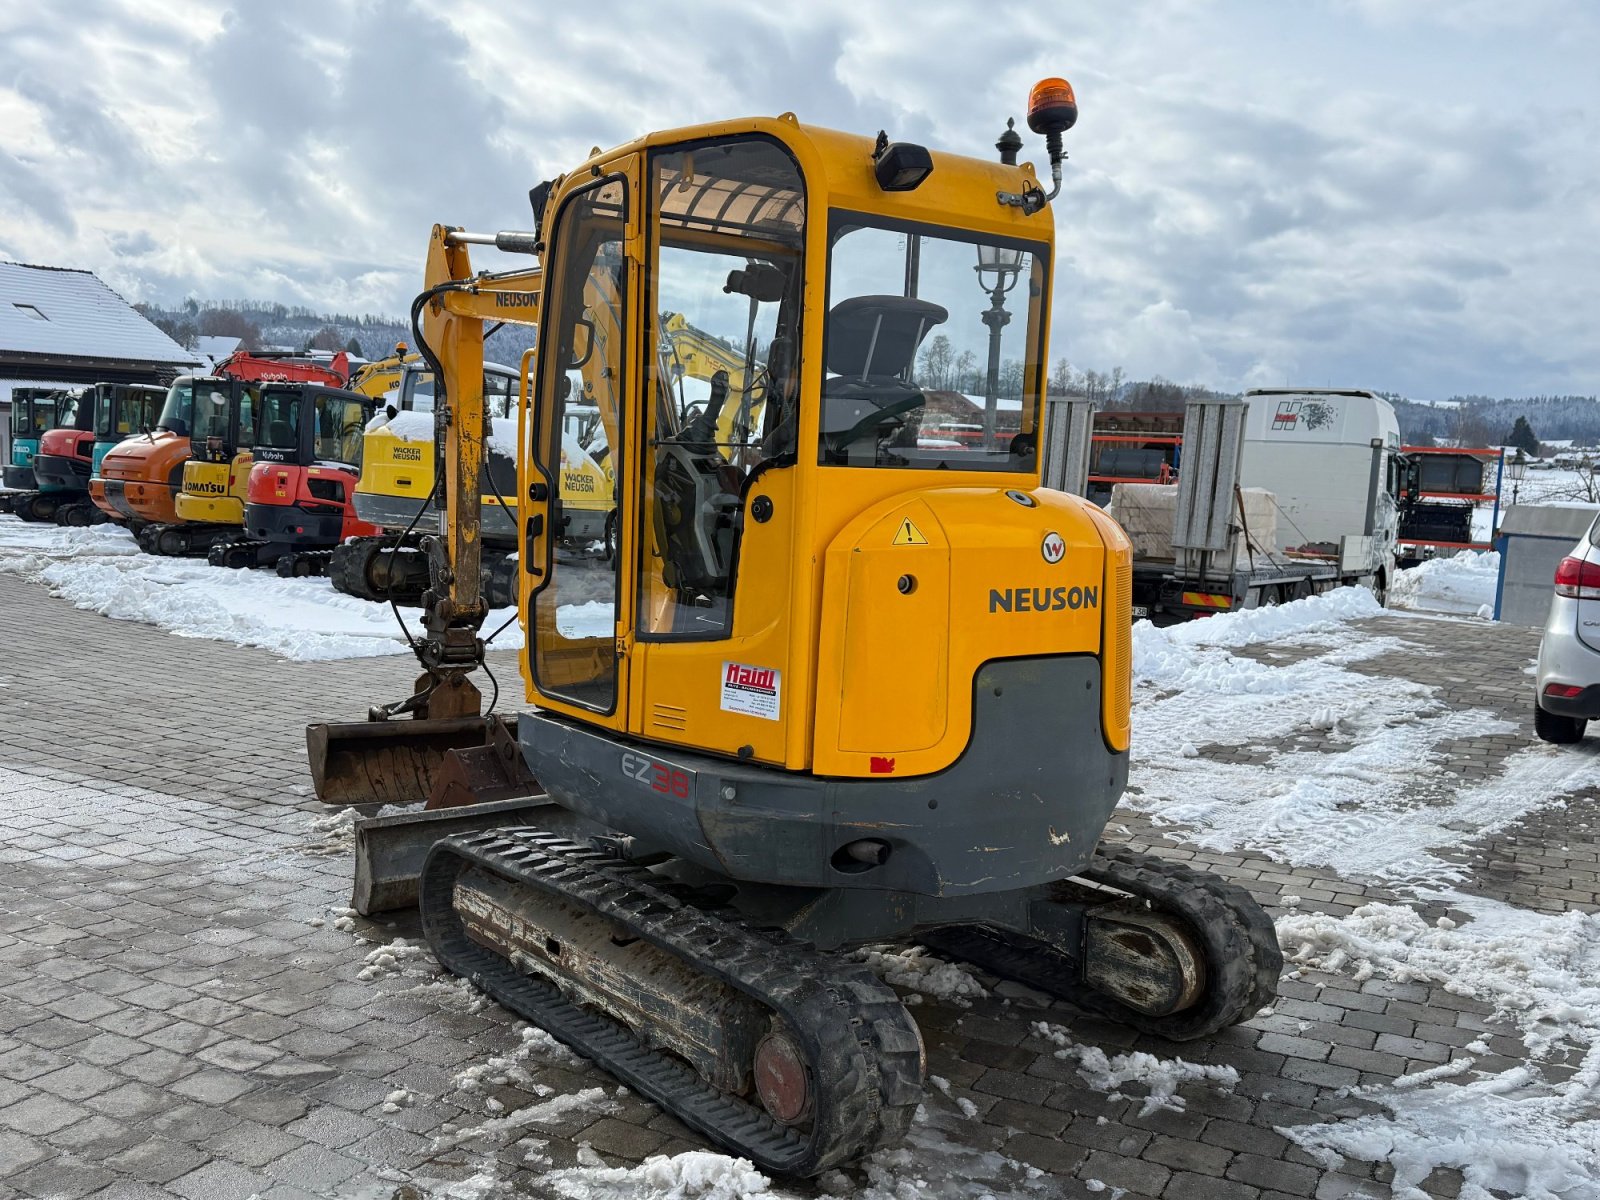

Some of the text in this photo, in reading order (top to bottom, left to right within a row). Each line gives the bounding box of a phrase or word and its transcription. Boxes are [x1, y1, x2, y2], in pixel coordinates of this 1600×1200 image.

[496, 292, 538, 307] NEUSON
[262, 451, 284, 461] Kubota
[393, 446, 421, 455] WACKER
[392, 453, 421, 461] NEUSON
[565, 472, 594, 484] WACKER
[564, 481, 595, 493] NEUSON
[989, 586, 1098, 613] NEUSON
[726, 663, 776, 690] Haidl
[622, 752, 689, 799] EZ38
